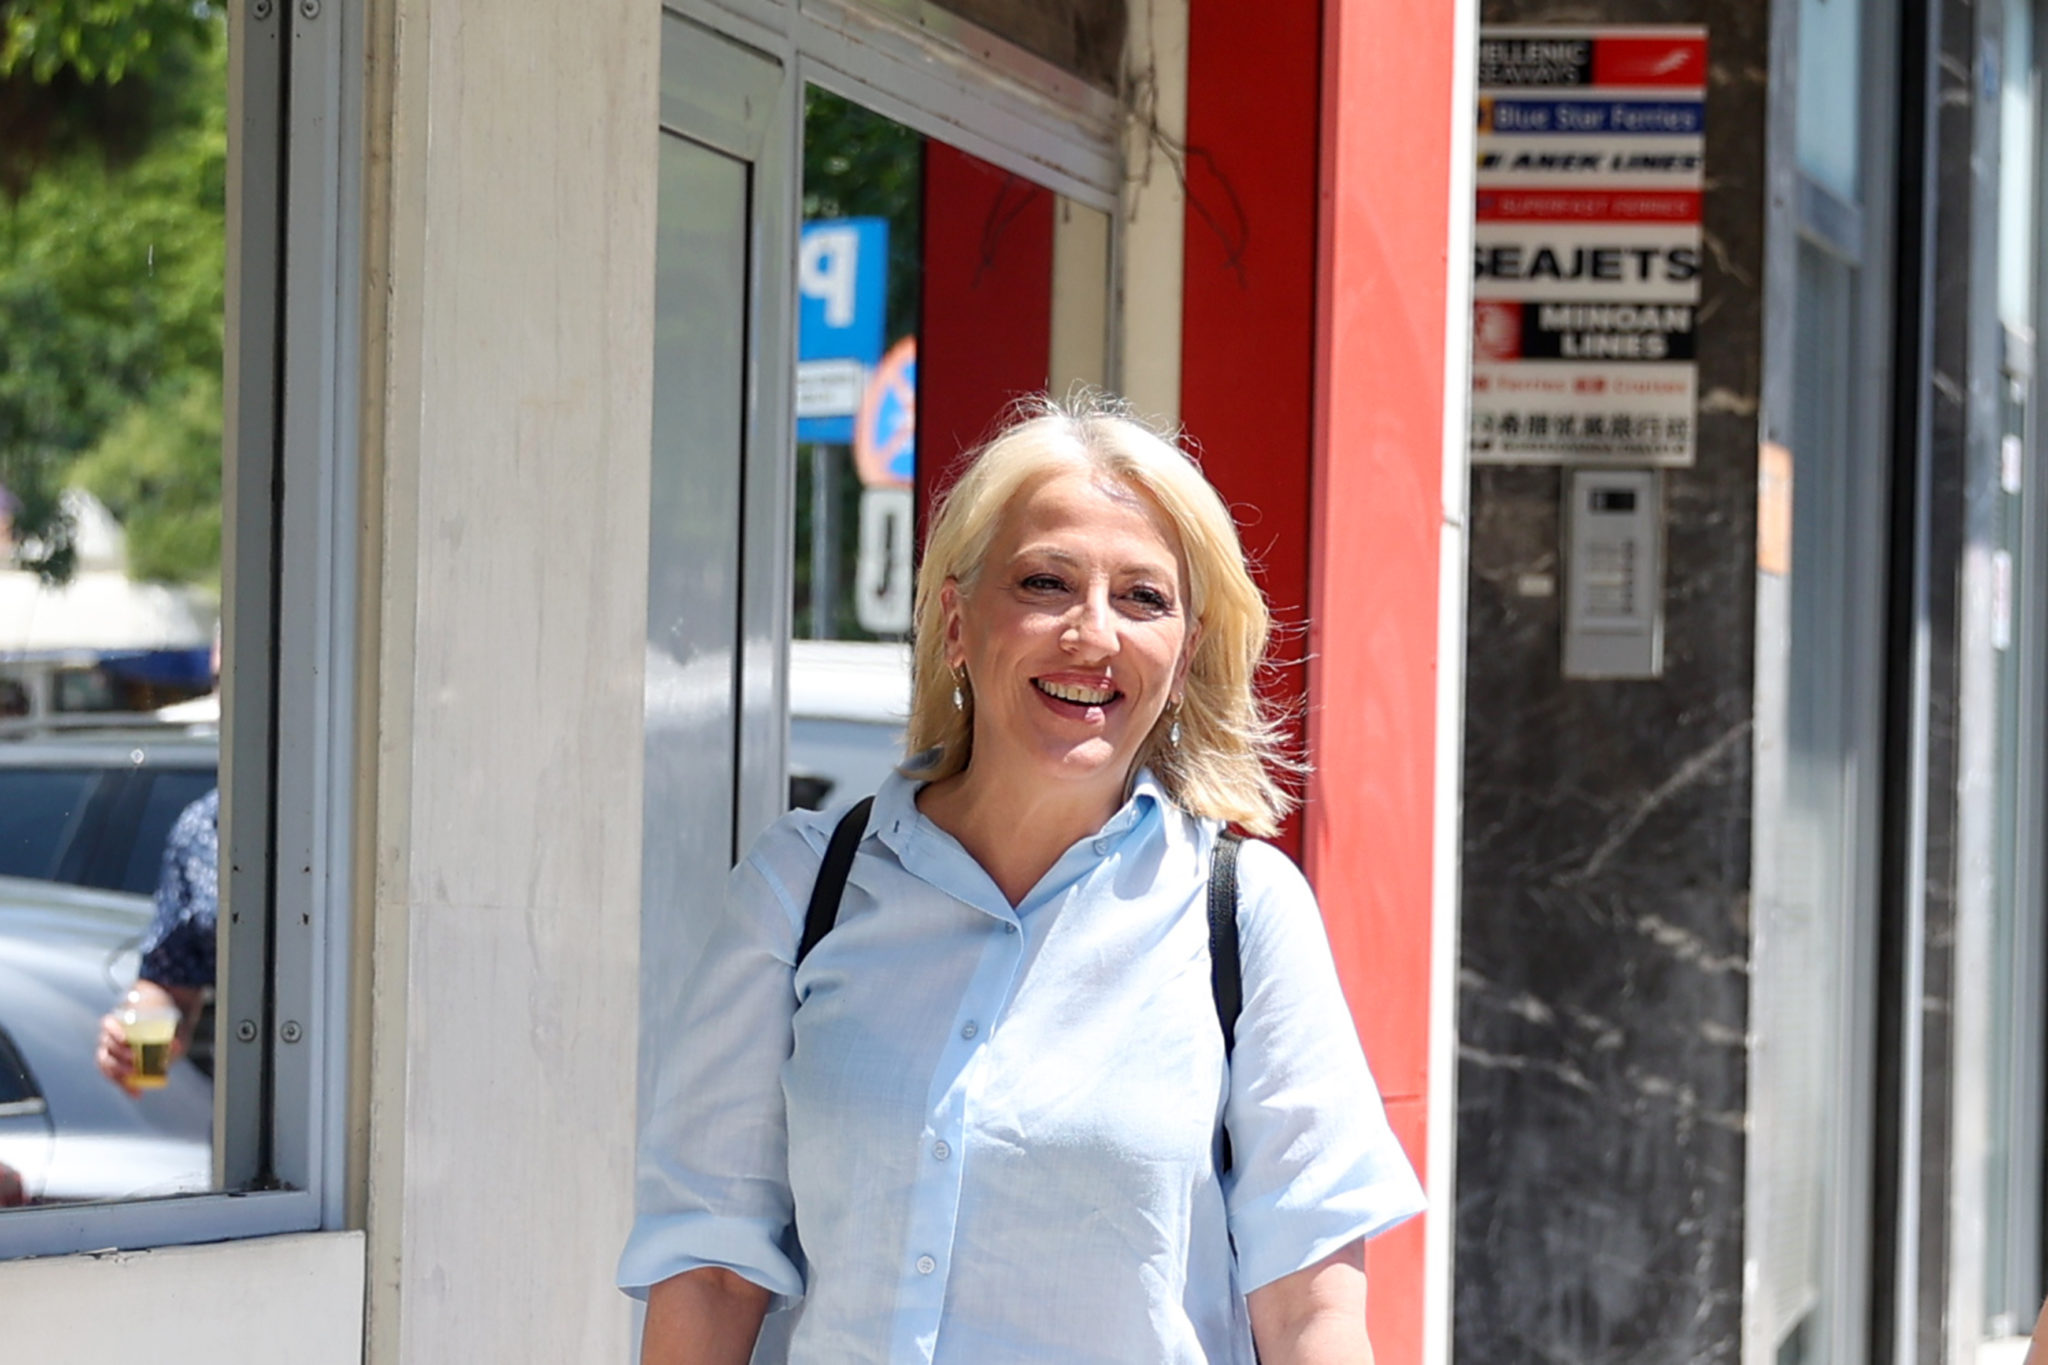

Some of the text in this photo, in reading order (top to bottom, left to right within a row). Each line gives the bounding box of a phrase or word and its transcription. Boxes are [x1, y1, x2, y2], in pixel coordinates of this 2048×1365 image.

[1497, 103, 1698, 129] Blue Star Ferries
[1539, 304, 1691, 332] MINOAN
[1560, 334, 1669, 358] LINES
